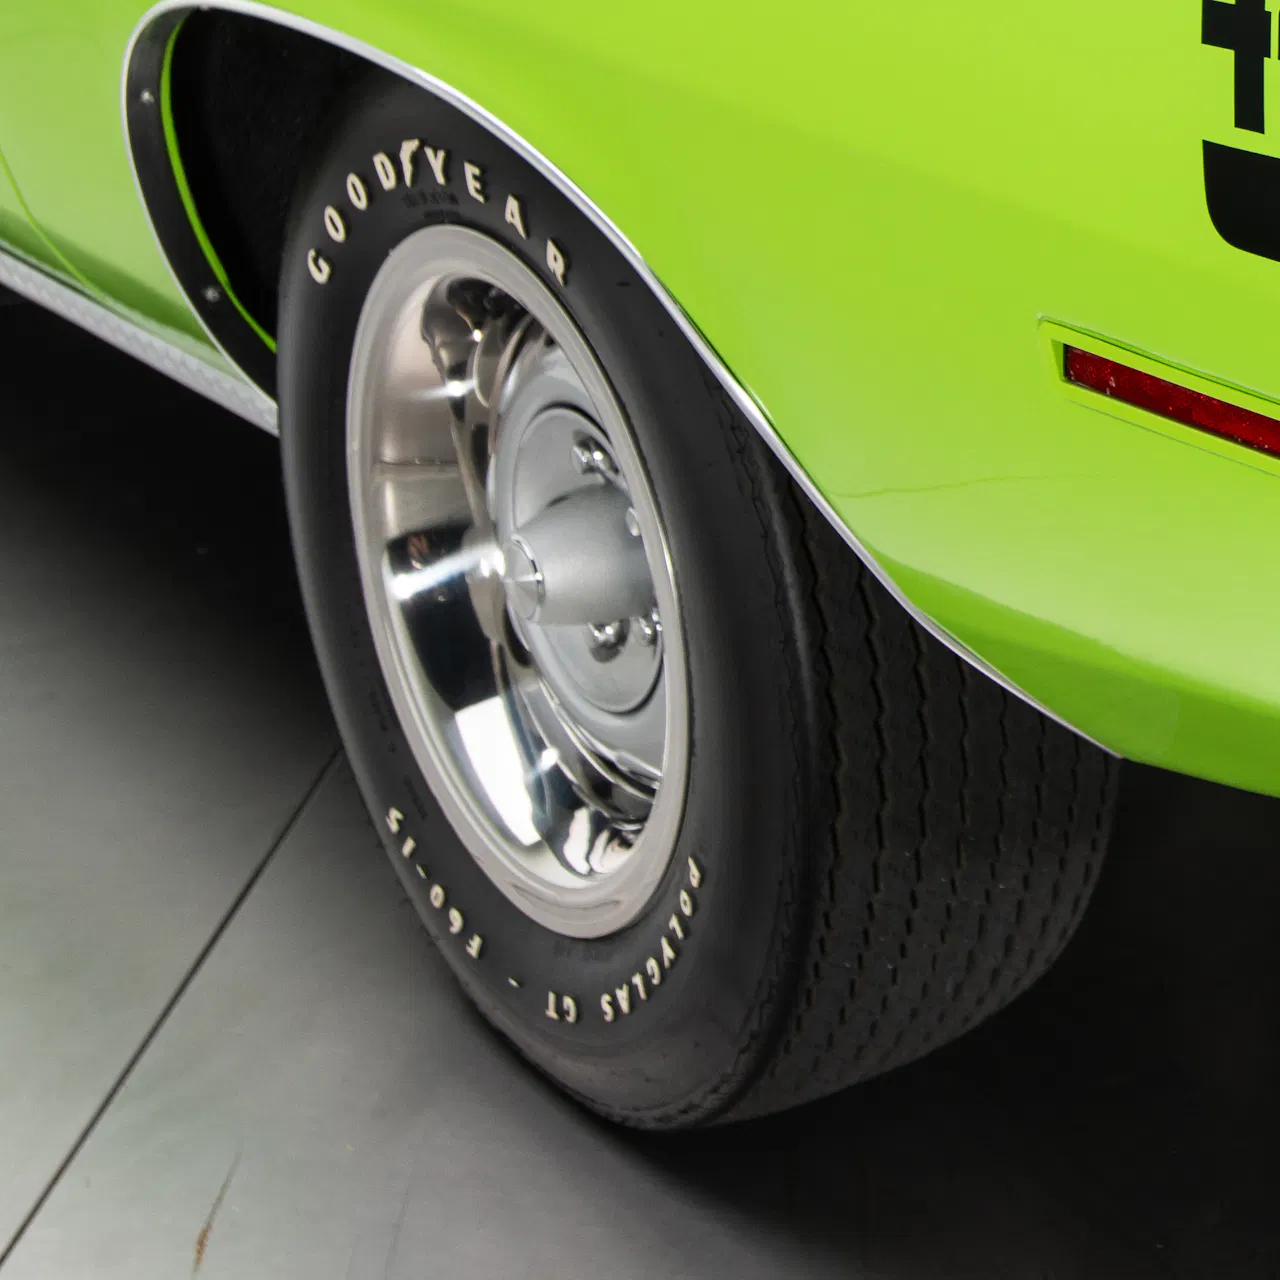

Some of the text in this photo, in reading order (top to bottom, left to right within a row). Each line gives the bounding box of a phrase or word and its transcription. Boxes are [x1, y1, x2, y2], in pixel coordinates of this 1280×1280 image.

[307, 141, 566, 287] GOODYEAR
[386, 807, 483, 960] F60-15
[600, 856, 701, 1022] POLYGLAS
[545, 991, 577, 1022] GT
